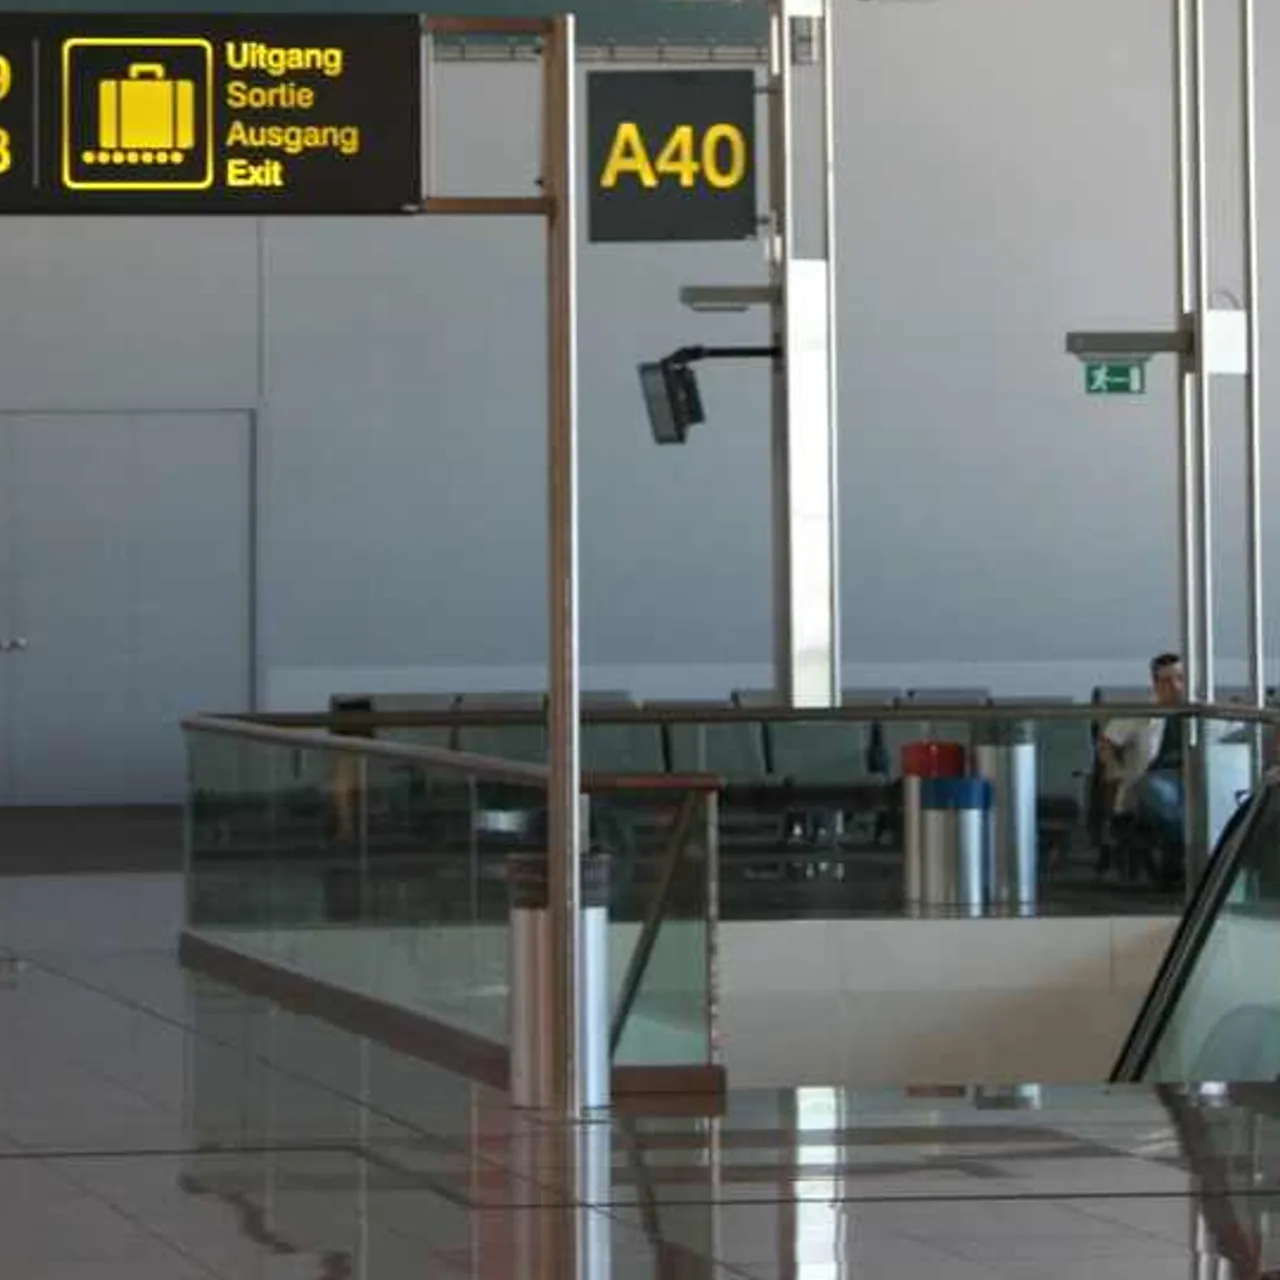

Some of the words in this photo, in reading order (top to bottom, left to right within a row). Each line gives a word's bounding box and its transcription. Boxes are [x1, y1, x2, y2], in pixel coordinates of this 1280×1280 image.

[224, 41, 345, 78] Uitgang
[225, 79, 316, 110] Sortie
[225, 122, 361, 156] Ausgang
[600, 121, 748, 190] A40
[224, 157, 285, 188] Exit
